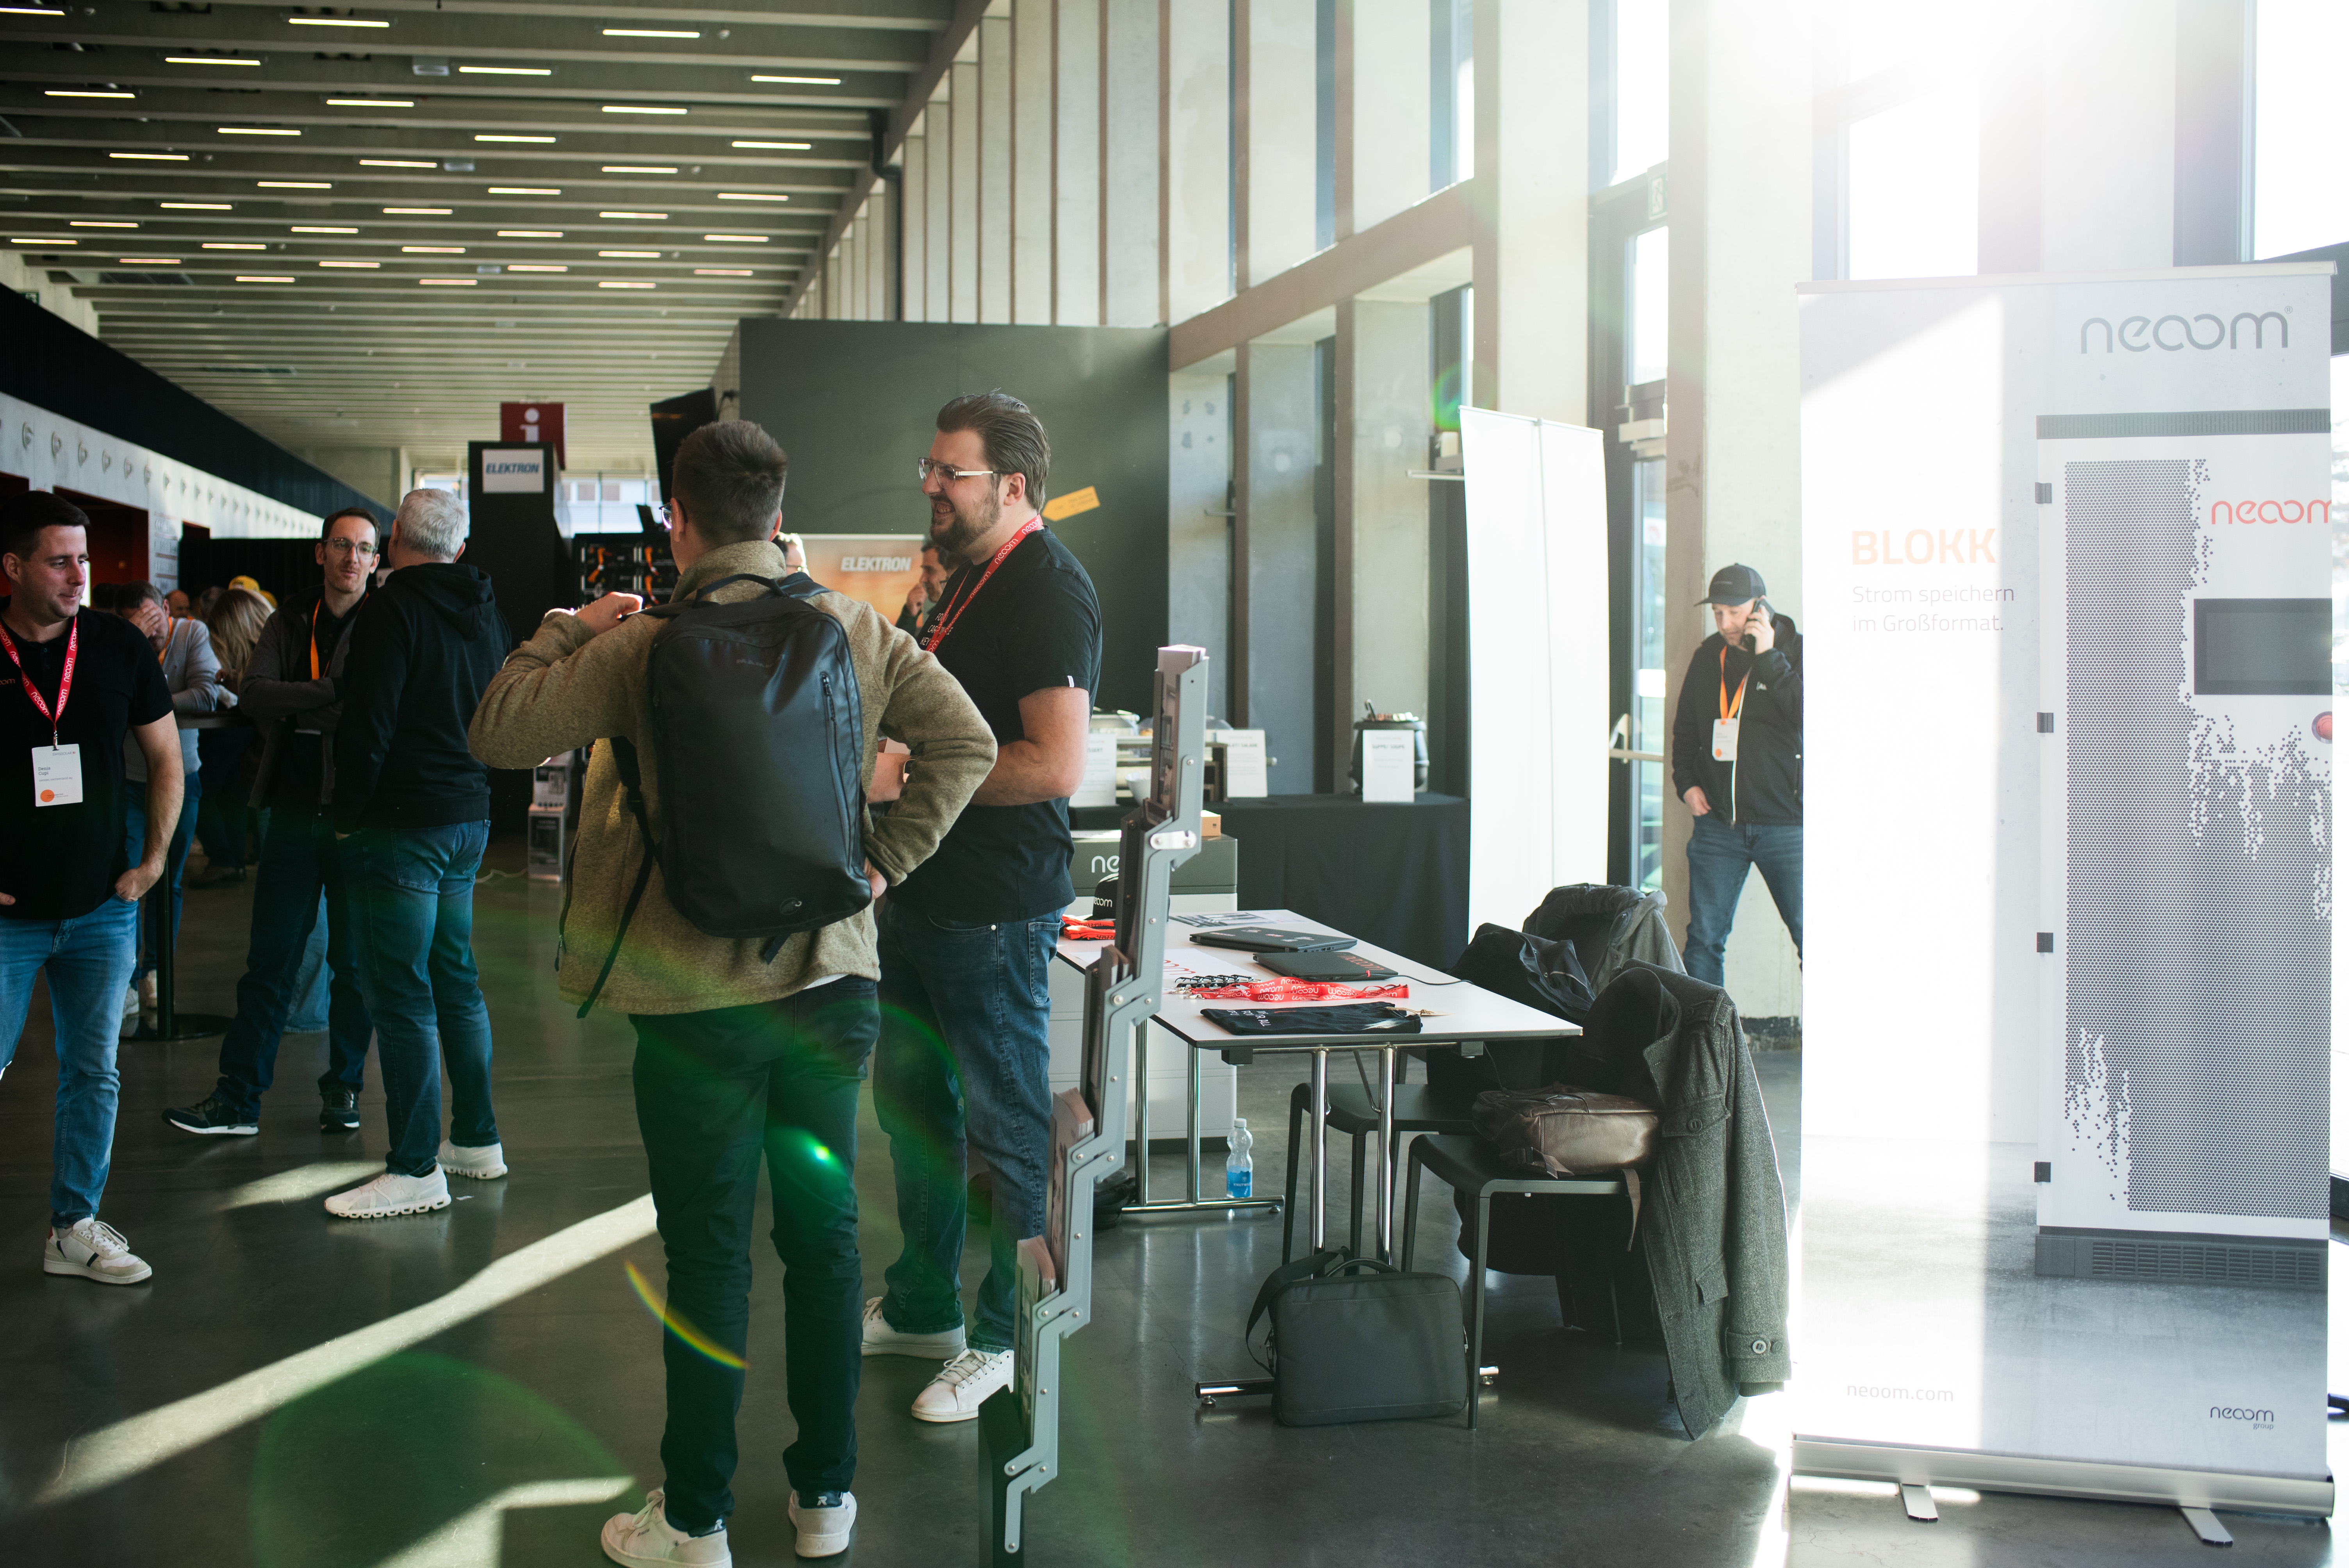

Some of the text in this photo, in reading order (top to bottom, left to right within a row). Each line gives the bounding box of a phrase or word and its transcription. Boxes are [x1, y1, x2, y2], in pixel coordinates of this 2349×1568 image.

[486, 462, 539, 474] ELEKTRON
[1021, 519, 1041, 535] neoom
[994, 538, 1018, 565] neoom
[1852, 528, 1997, 565] BLOKK
[841, 557, 912, 572] ELEKTRON
[970, 571, 991, 599] neoom
[1853, 585, 2014, 606] Strom speichern
[1854, 614, 2003, 631] im Großformat.
[63, 658, 73, 682] neoom
[31, 692, 49, 716] neoom
[57, 689, 68, 715] neoom
[1094, 897, 1112, 907] eoom
[1847, 1385, 1953, 1402] neoom.com
[2210, 1406, 2274, 1422] neoom
[2253, 1422, 2274, 1430] group
